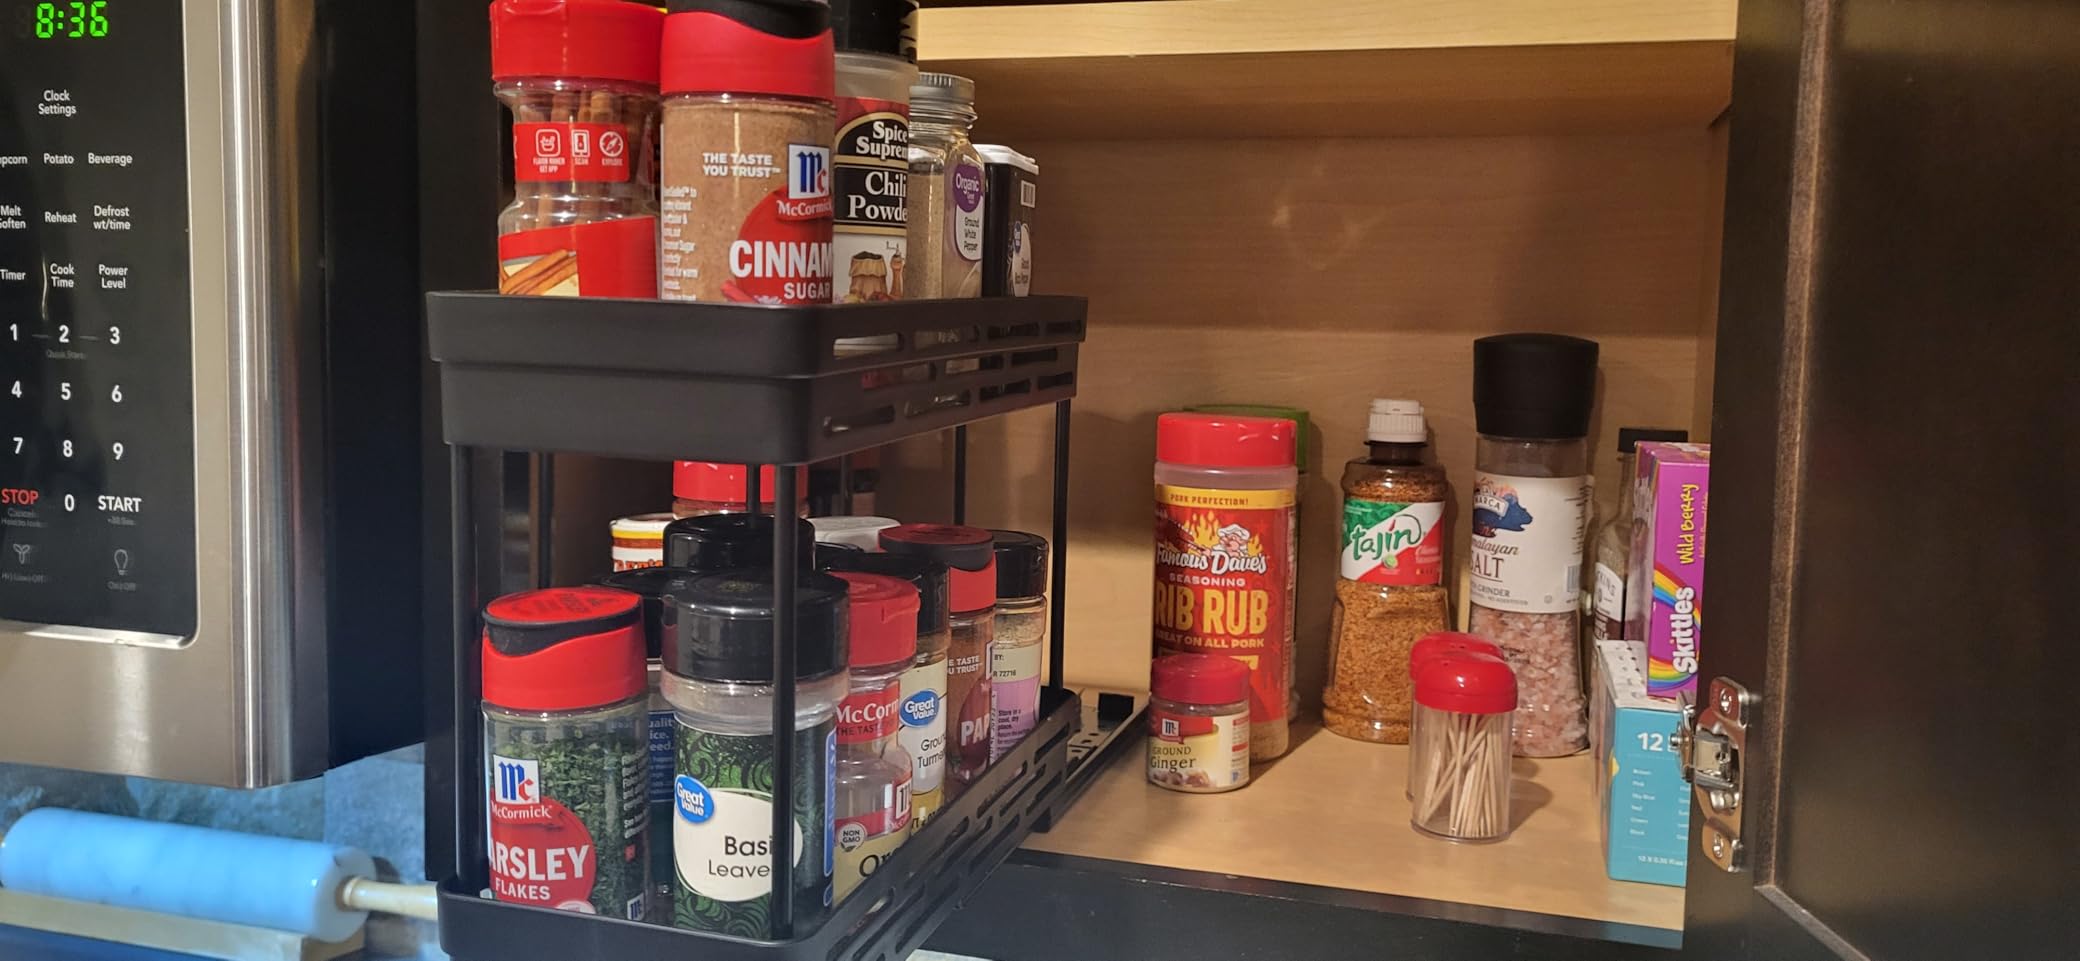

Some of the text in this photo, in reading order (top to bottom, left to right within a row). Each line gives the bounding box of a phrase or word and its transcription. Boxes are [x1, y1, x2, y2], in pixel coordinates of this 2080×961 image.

[36, 1, 109, 38] 8:36
[43, 89, 70, 102] Clock
[38, 103, 77, 117] Settings
[873, 121, 908, 145] Spice
[856, 136, 908, 161] Suprem
[0, 155, 28, 168] pcorn
[43, 153, 75, 165] Potato
[88, 152, 133, 167] Beverage
[703, 153, 772, 166] THE TASTE
[703, 165, 728, 176] YOU
[865, 171, 907, 198] Chili
[955, 173, 980, 194] Organic
[0, 205, 21, 216] Melt
[93, 205, 130, 218] Defrost
[777, 199, 832, 217] McCormic
[848, 194, 908, 222] Powde
[44, 211, 77, 224] Reheat
[93, 219, 131, 231] wt/time
[729, 240, 833, 278] CINNAM
[0, 268, 26, 281] Timer
[50, 263, 75, 276] Cook
[98, 264, 129, 277] Power
[51, 276, 75, 289] Time
[101, 276, 127, 290] Level
[784, 282, 831, 300] SUGAR
[9, 324, 19, 341] 1
[58, 325, 70, 343] 2
[109, 326, 121, 345] 3
[11, 380, 23, 398] 4
[60, 382, 72, 401] 5
[111, 384, 123, 403] 6
[13, 437, 24, 454] 7
[62, 439, 73, 458] 8
[112, 442, 124, 461] 9
[1, 488, 39, 505] STOP
[64, 494, 75, 512] 0
[97, 495, 142, 513] START
[1191, 495, 1248, 505] PERFECTION!
[1472, 537, 1519, 556] alayan
[1675, 533, 1695, 565] Wild
[1157, 542, 1267, 575] Famous Dave's
[1471, 553, 1504, 578] ALT
[1169, 572, 1246, 587] SEASONING
[1155, 579, 1269, 636] RIB RUB
[1156, 630, 1264, 649] REAT ON ALL PORK
[1671, 586, 1698, 675] Skittles
[957, 656, 980, 667] TASTE
[957, 664, 981, 674] TRUST
[999, 669, 1017, 677] 72716
[836, 699, 898, 724] McCorm
[904, 696, 935, 716] Great
[648, 730, 670, 740] ice.
[1637, 732, 1664, 752] 12
[1152, 746, 1191, 756] GROUND
[917, 752, 944, 769] Turme
[1151, 756, 1197, 774] Ginger
[677, 782, 705, 807] Great
[681, 798, 705, 817] Value
[724, 834, 773, 857] Basi
[843, 836, 861, 844] GMO
[488, 840, 590, 881] ARSLEY
[708, 858, 770, 878] Leave
[859, 853, 892, 878] Or
[495, 877, 551, 901] FLAKES
